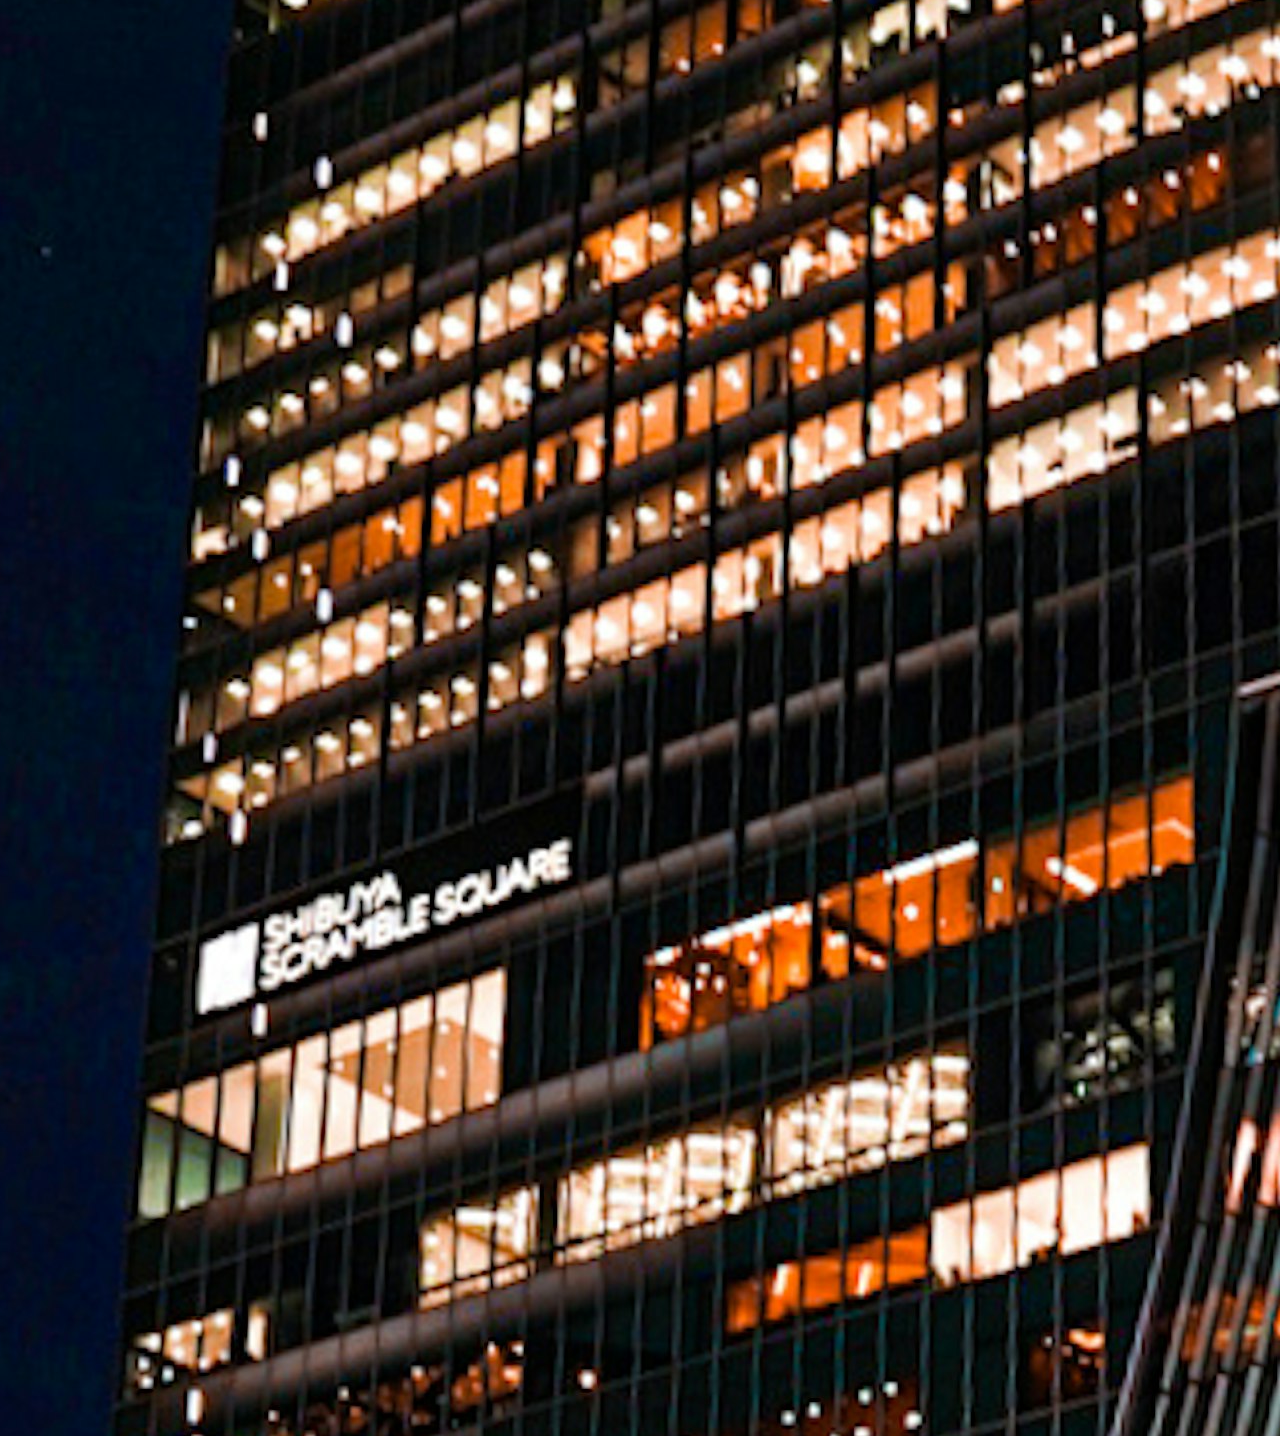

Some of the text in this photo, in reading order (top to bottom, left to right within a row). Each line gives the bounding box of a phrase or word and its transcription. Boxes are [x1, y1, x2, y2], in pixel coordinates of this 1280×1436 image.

[260, 837, 574, 991] SCRAMBLE SQUARE
[265, 871, 403, 951] SHIBUYA
